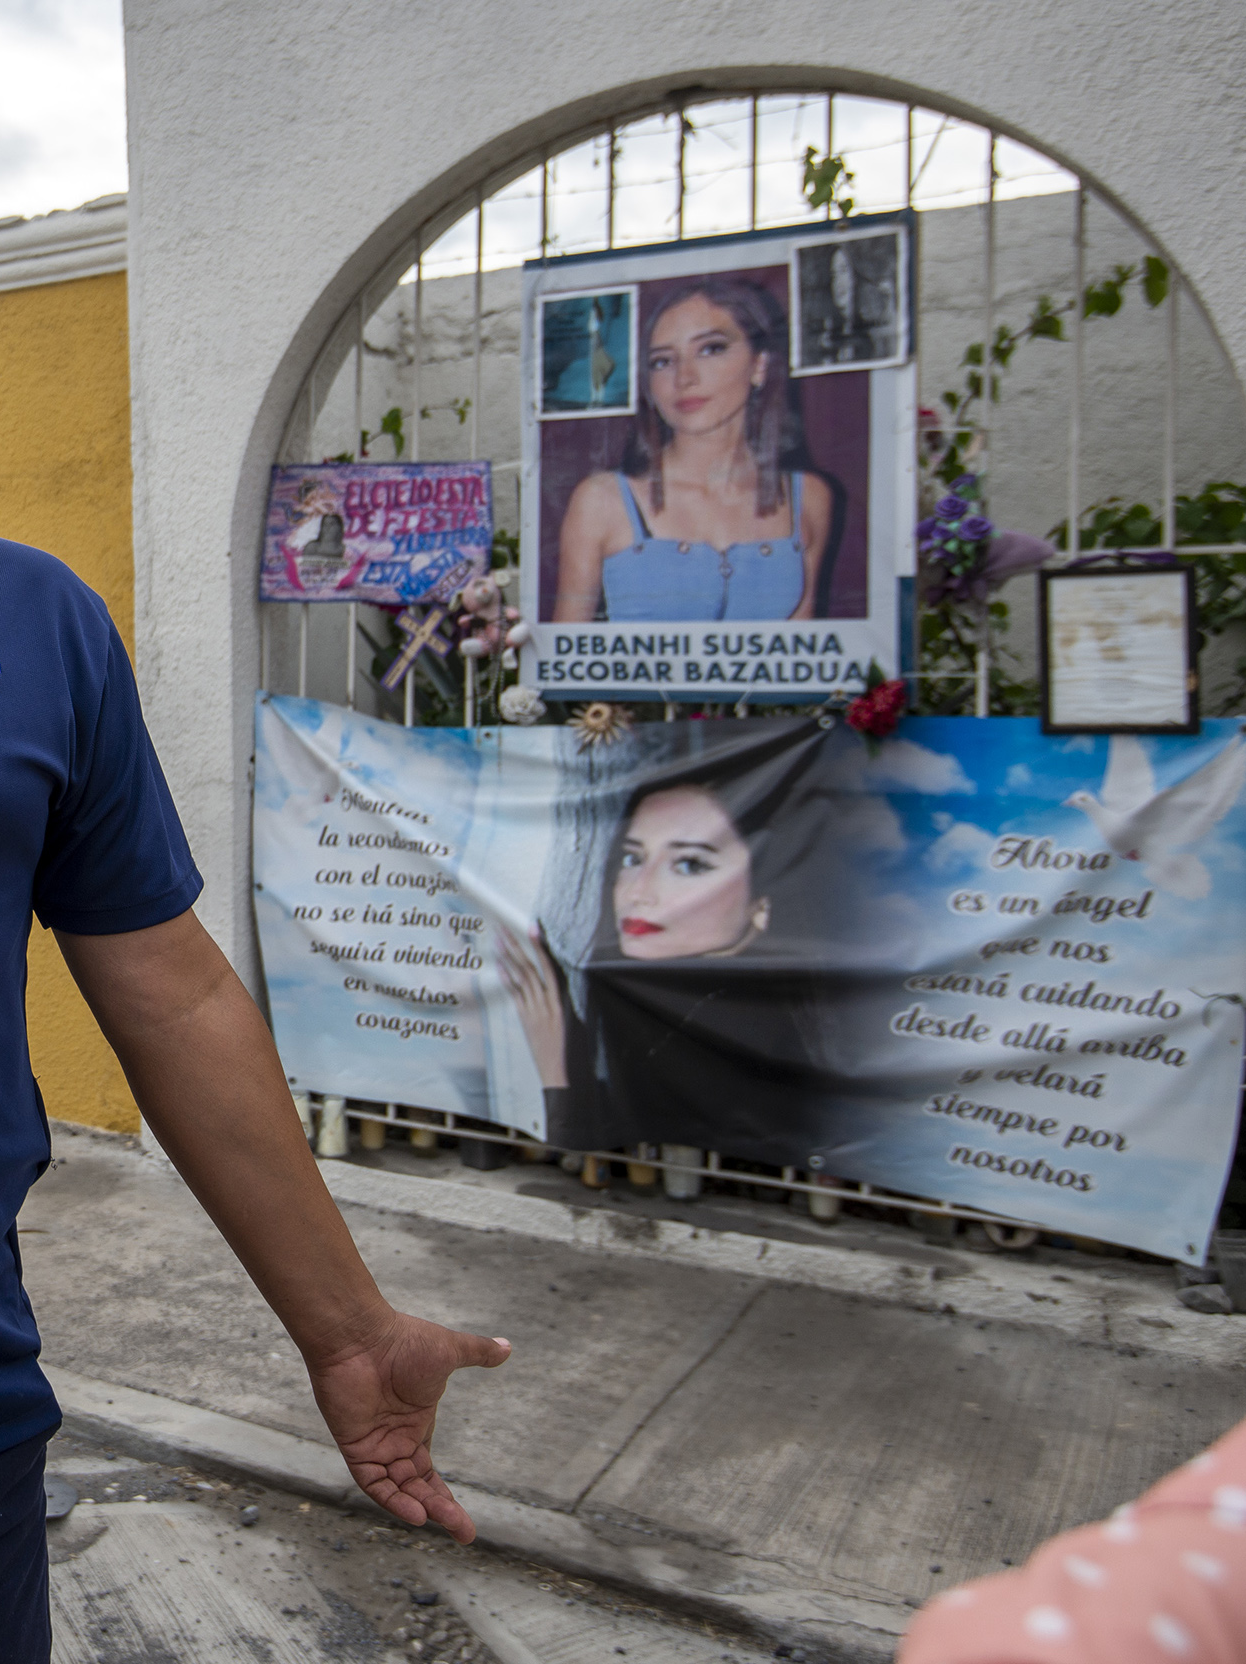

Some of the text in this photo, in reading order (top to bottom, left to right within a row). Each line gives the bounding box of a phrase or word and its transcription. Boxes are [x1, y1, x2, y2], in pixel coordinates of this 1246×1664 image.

[345, 476, 486, 511] EL CIELO ESTA
[344, 507, 480, 538] DE FIESTA
[555, 633, 842, 655] DEBANHI SUSANA
[537, 661, 868, 683] ESCOBAR BAZALDUA
[318, 825, 340, 847] la
[992, 835, 1111, 871] Ahora
[315, 867, 354, 886] con
[362, 864, 380, 886] el
[294, 904, 485, 935] no se irá sino que
[953, 890, 1153, 922] es un ángel
[310, 939, 483, 970] seguirá viviendo
[979, 936, 1111, 963] que nos
[344, 975, 459, 1006] en nuestros
[907, 972, 1181, 1020] estará cuidando
[356, 1012, 460, 1040] corazones
[894, 1007, 1187, 1067] desde allá arriba
[958, 1064, 1106, 1099] y velará
[928, 1093, 1127, 1152] siempre por
[949, 1146, 1093, 1192] nosotros
